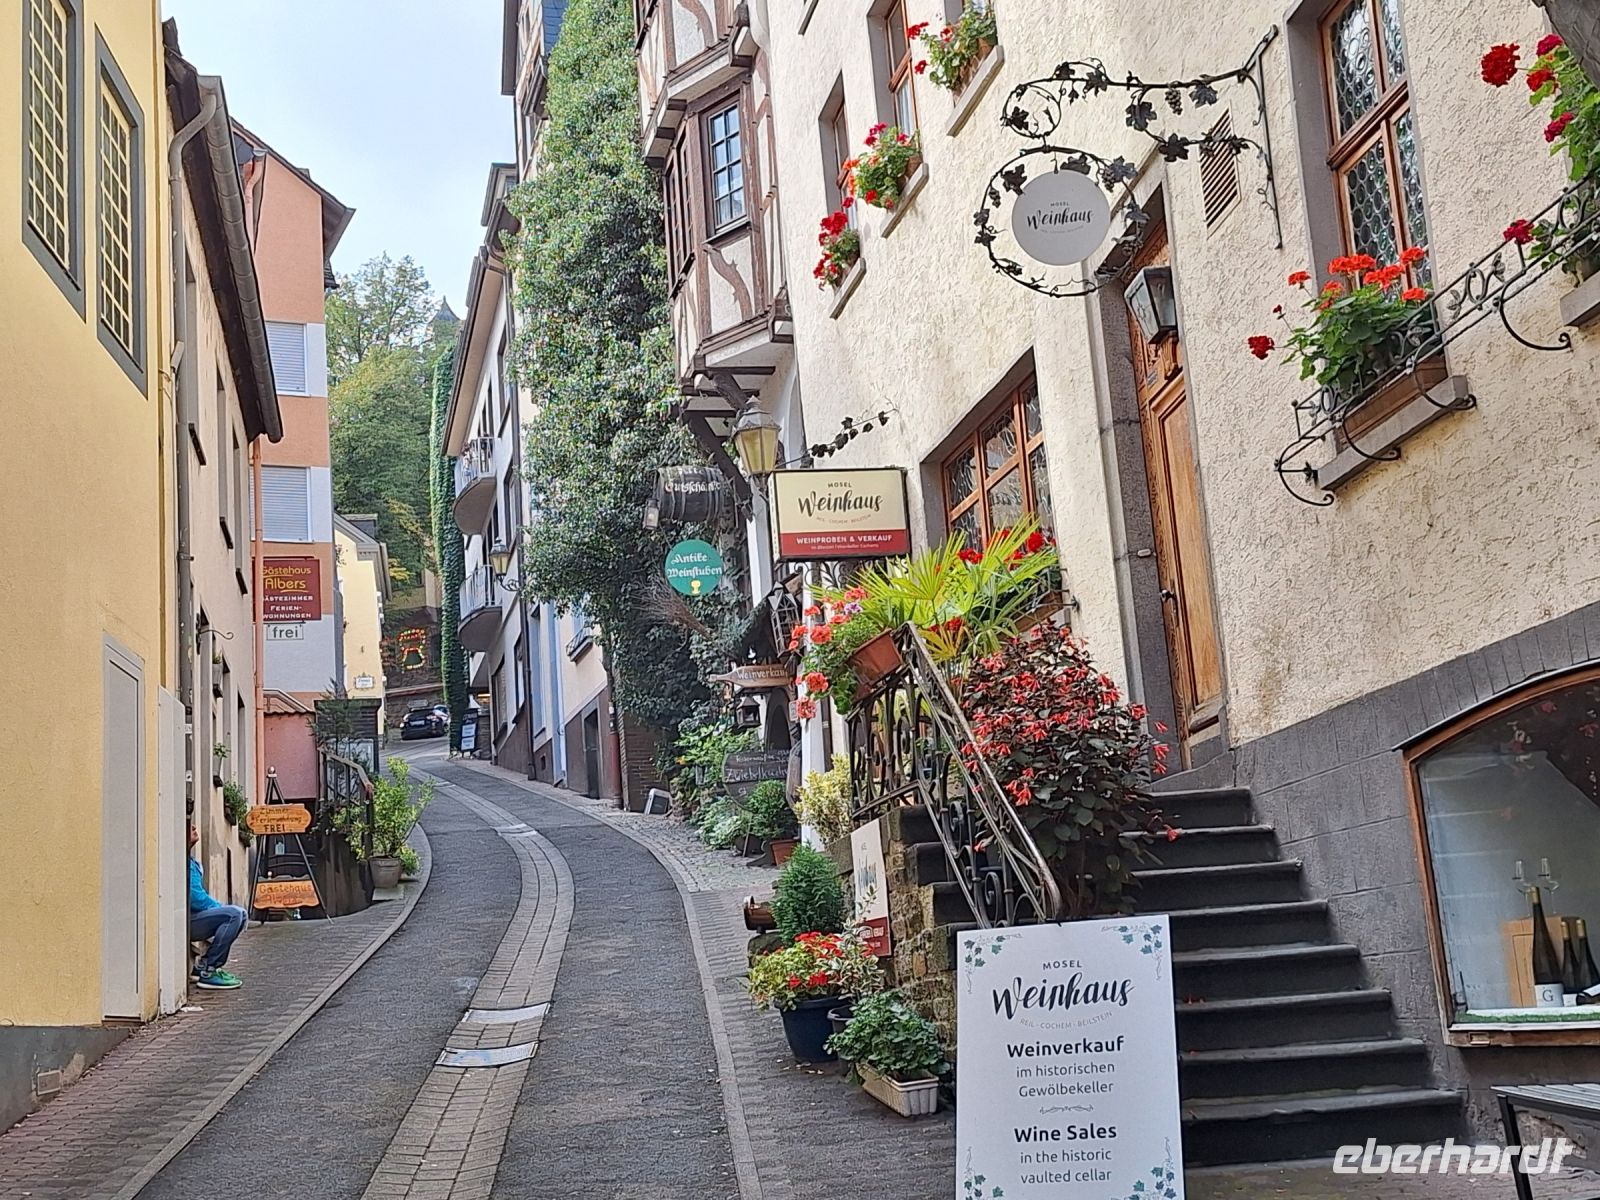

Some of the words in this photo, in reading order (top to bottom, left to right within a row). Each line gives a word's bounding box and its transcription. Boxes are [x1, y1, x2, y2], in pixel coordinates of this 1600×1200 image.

[1027, 208, 1095, 230] Weinhaus
[798, 489, 883, 517] Weinhaus
[796, 535, 847, 544] WEINPROBEN
[857, 534, 892, 542] VERKAUF
[671, 553, 708, 564] Antike
[265, 578, 307, 589] Albers
[272, 626, 299, 639] frei
[264, 824, 286, 832] FREI
[1042, 959, 1083, 970] MOSEL
[992, 972, 1136, 1020] Weinhaus
[1542, 989, 1554, 1002] G
[1019, 1018, 1035, 1027] REIL
[1077, 1012, 1112, 1027] BEILSTEIN
[1007, 1035, 1125, 1057] Weinverkauf
[1016, 1066, 1032, 1078] im
[1036, 1062, 1115, 1077] historischen
[1019, 1081, 1115, 1097] Gewölbekeller
[1014, 1126, 1061, 1143] Wine
[1067, 1123, 1117, 1140] Sales
[1020, 1152, 1032, 1164] in
[1036, 1150, 1058, 1163] the
[1062, 1148, 1112, 1162] historic
[1021, 1170, 1071, 1184] vaulted
[1075, 1168, 1112, 1182] cellar
